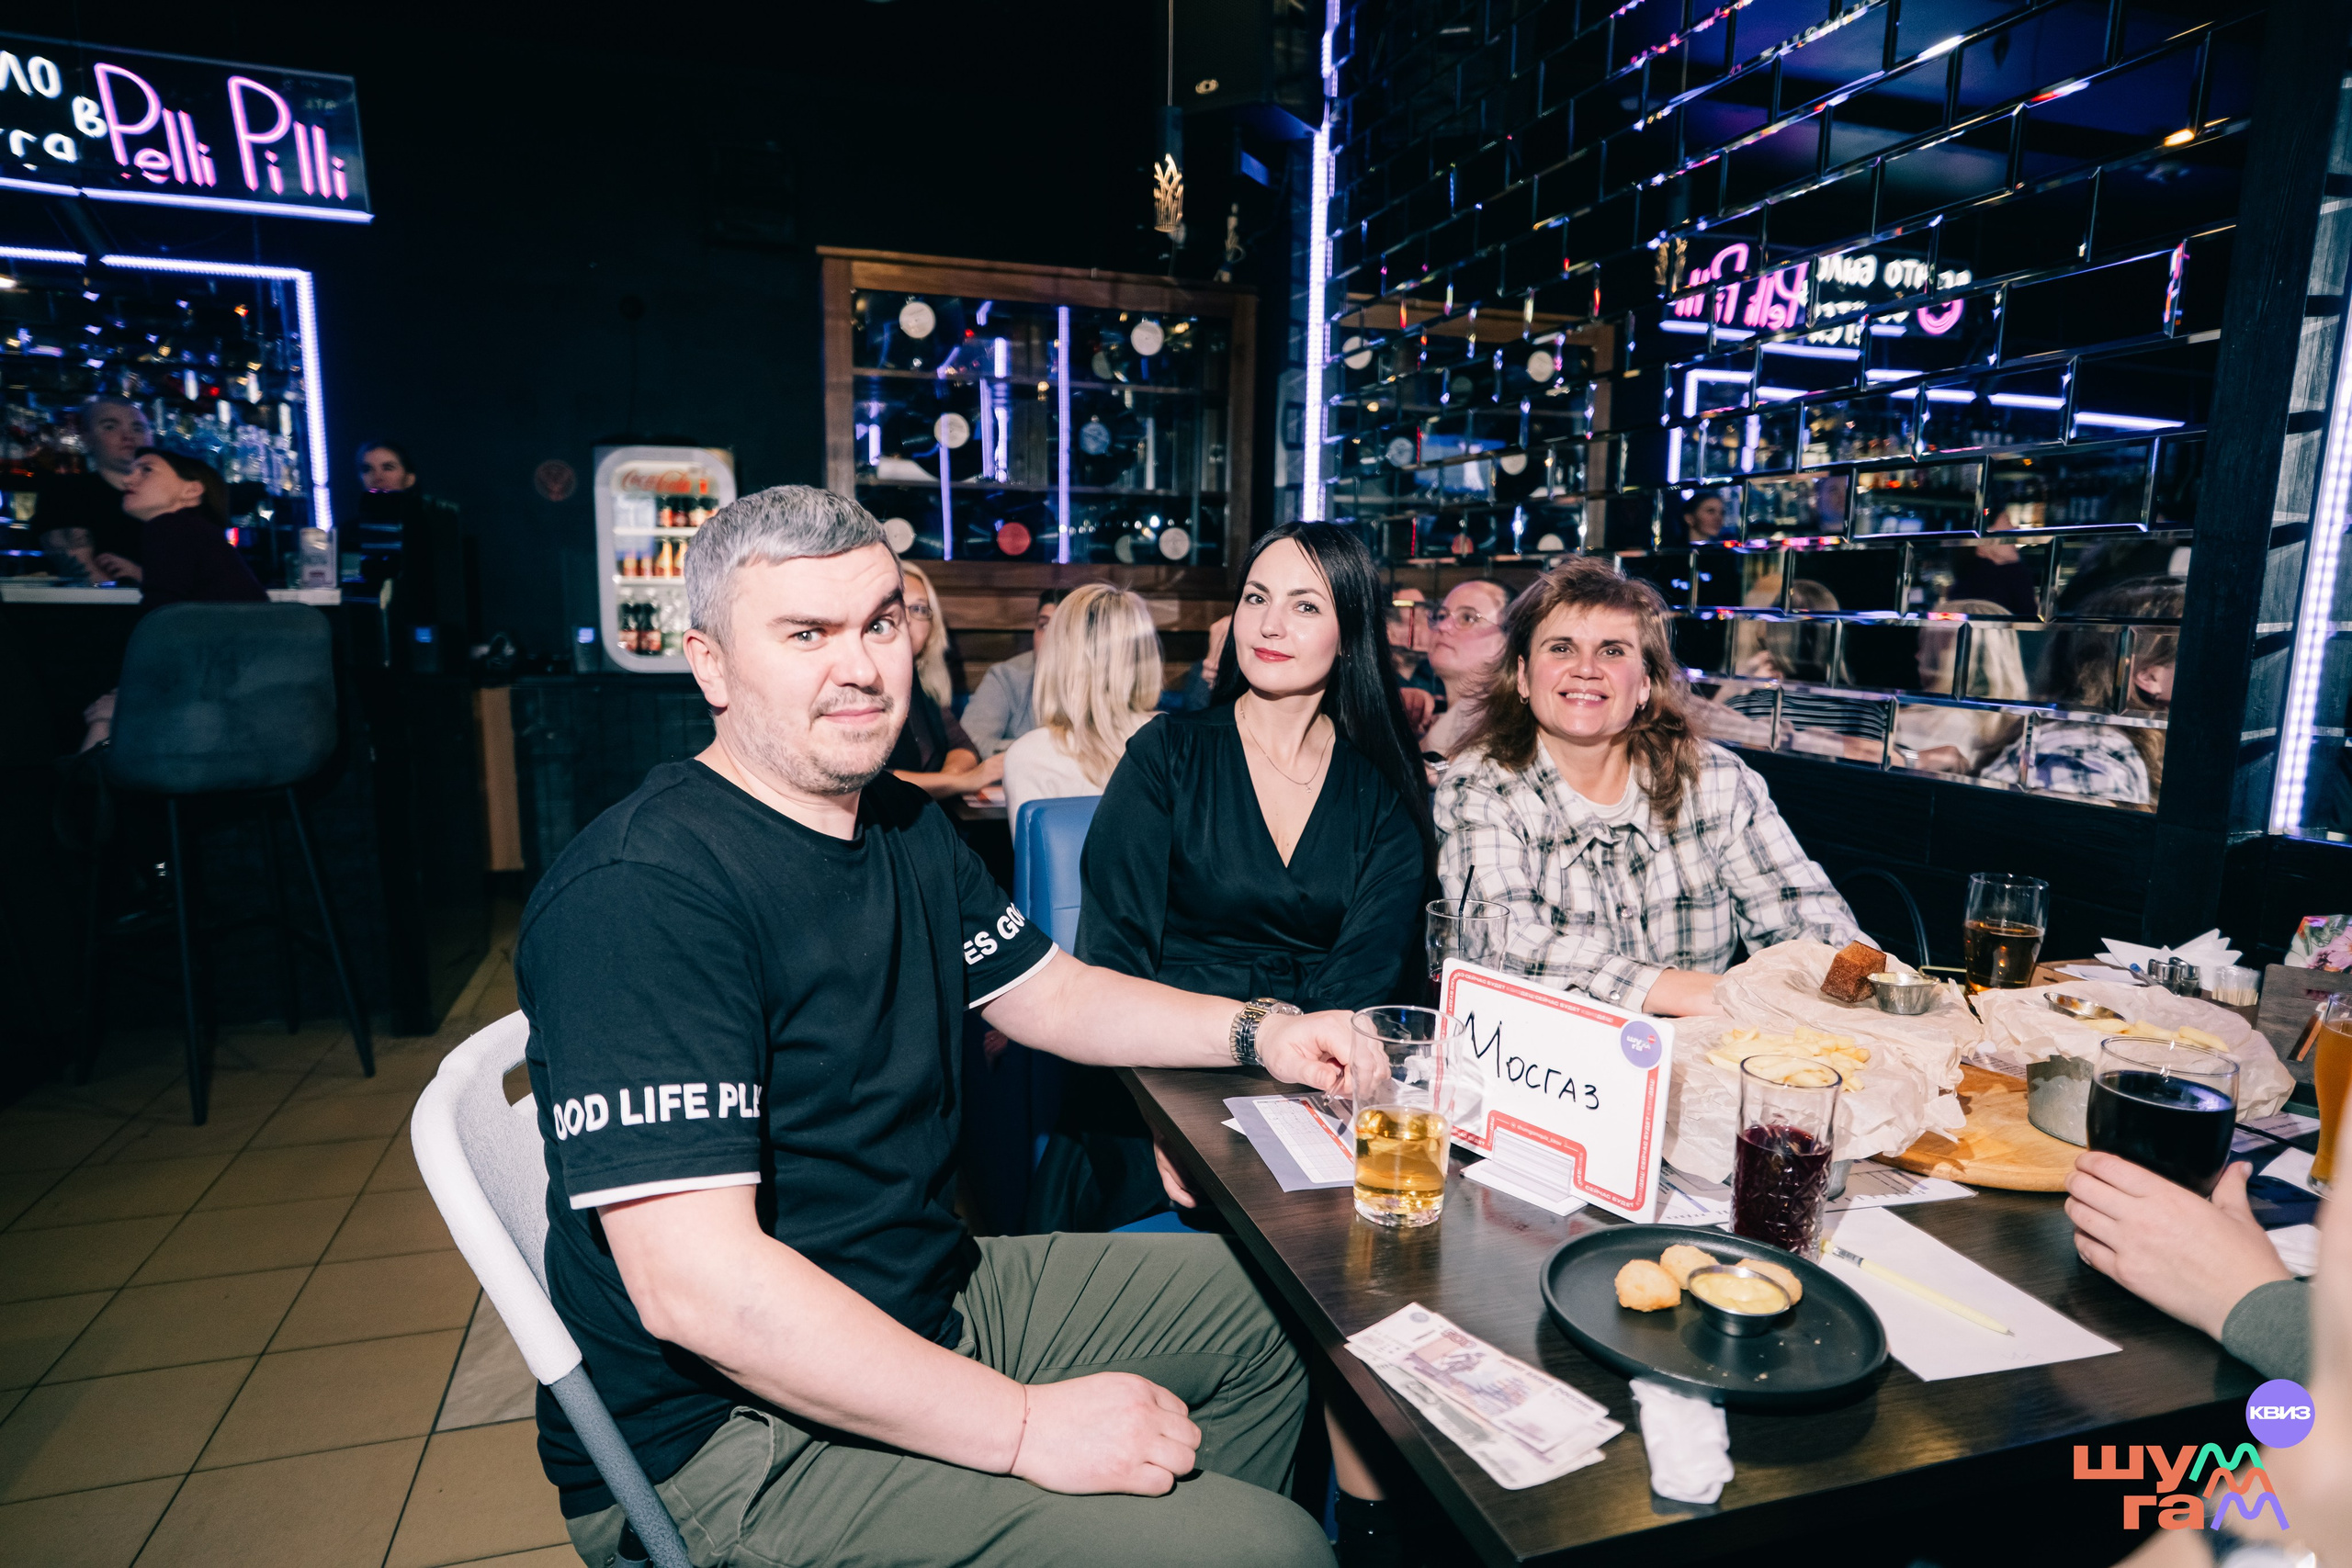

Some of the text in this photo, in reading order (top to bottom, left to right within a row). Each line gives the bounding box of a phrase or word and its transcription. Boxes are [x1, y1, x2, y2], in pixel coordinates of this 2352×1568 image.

[94, 62, 347, 200] Pelli Pilli
[619, 1082, 710, 1126] LIFE
